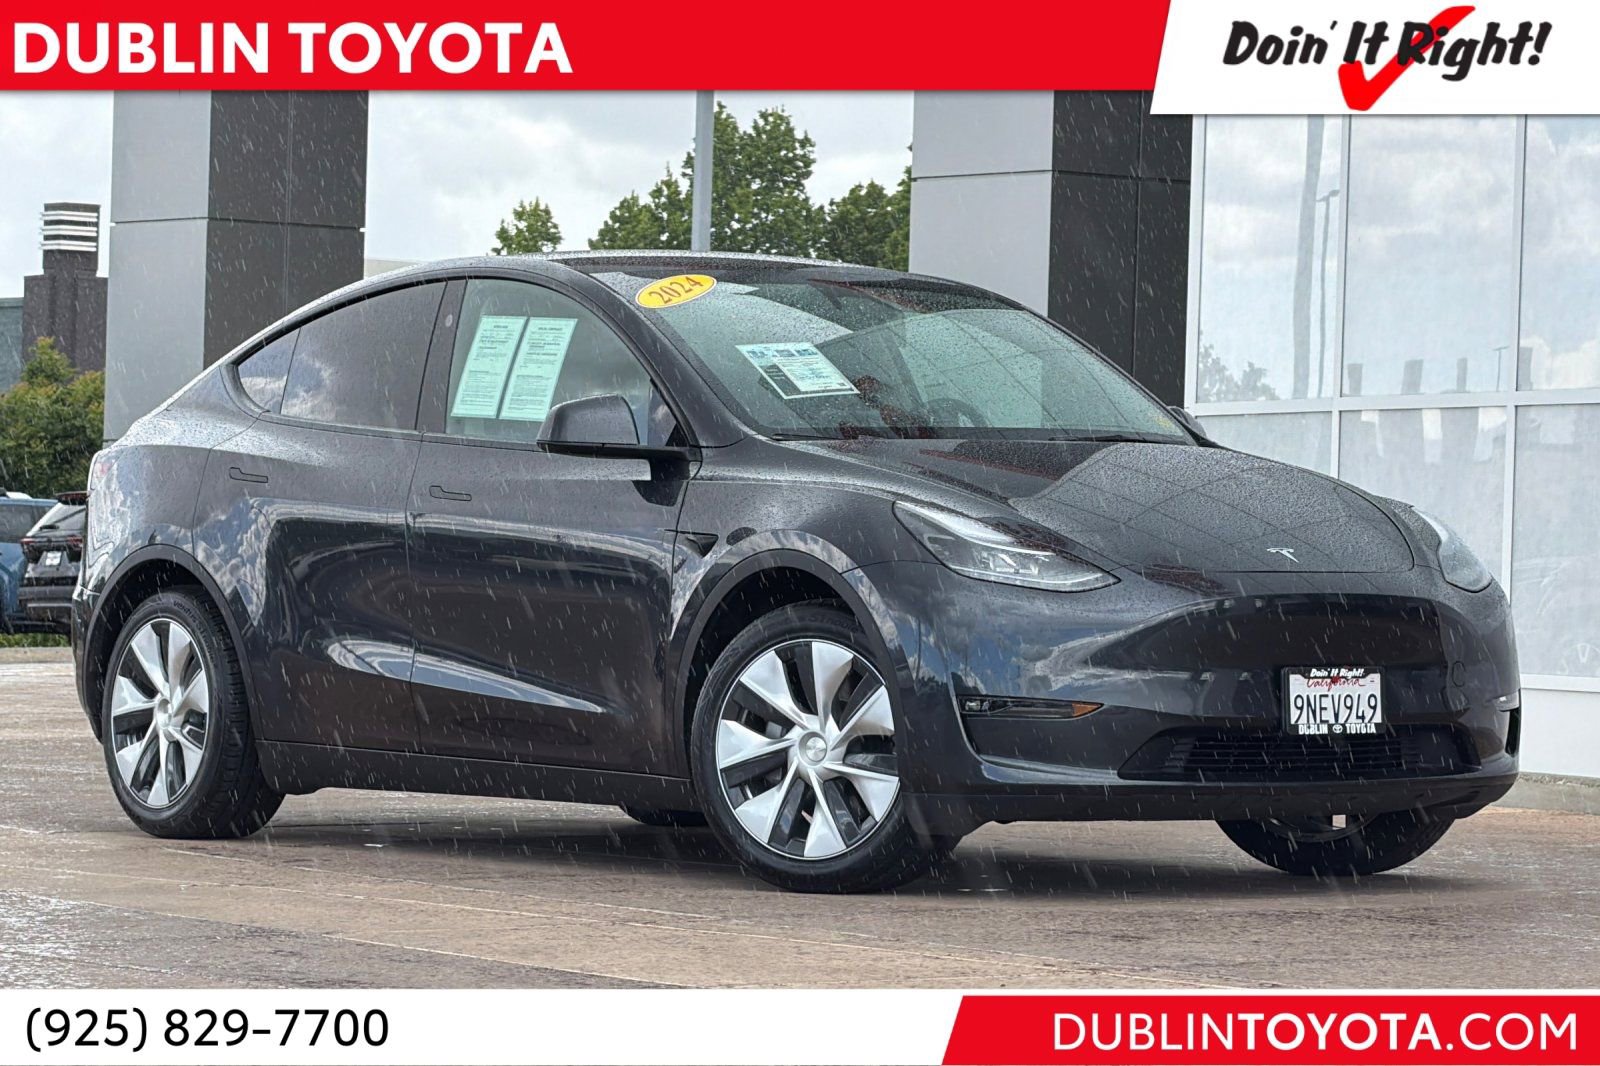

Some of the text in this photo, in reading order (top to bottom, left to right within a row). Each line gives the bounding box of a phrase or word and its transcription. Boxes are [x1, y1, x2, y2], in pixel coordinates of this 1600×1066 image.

[648, 276, 704, 304] 2024
[1330, 668, 1338, 677] It
[1339, 668, 1365, 679] Right!
[1306, 678, 1366, 691] California
[1294, 693, 1378, 724] 9NEV949
[1298, 723, 1377, 735] DUBLIN TOYOTA
